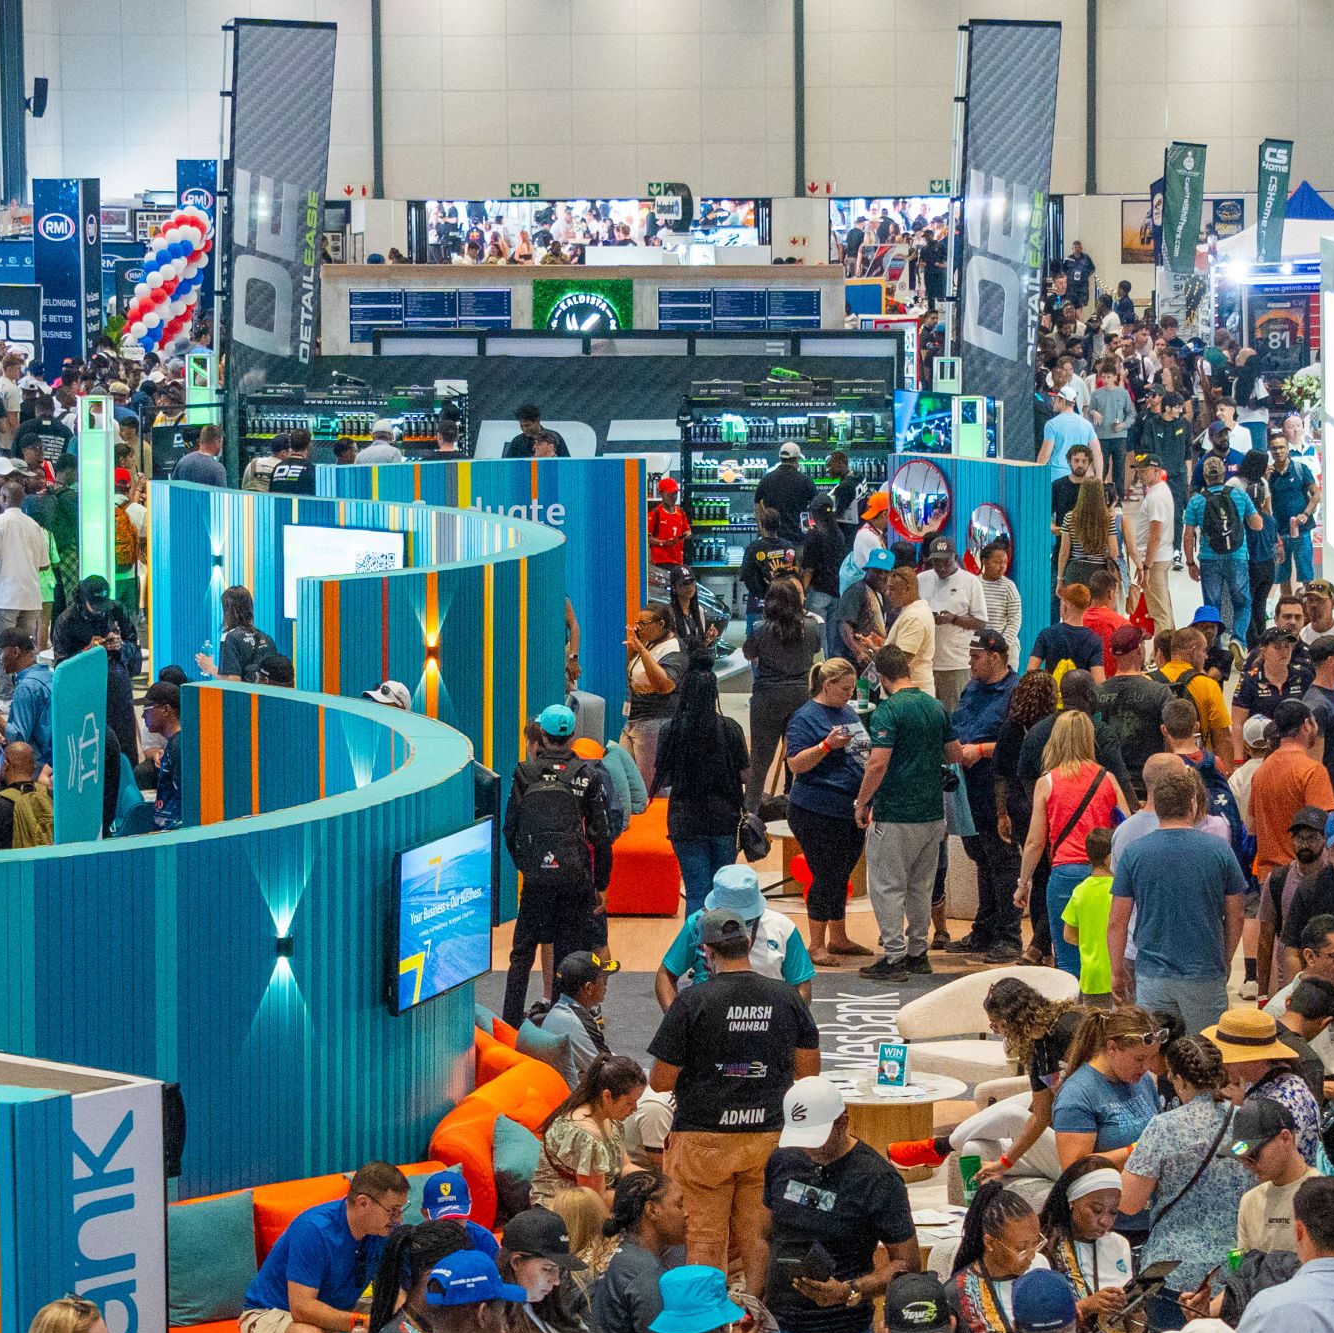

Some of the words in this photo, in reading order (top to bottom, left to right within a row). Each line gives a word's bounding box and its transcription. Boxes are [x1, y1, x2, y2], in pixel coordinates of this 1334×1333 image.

[299, 190, 319, 364] DETAILEASE
[49, 315, 73, 323] BETTER
[1268, 332, 1291, 349] 81
[273, 465, 304, 477] DE
[726, 1006, 772, 1019] ADARSH
[729, 1021, 769, 1032] (MAMBA)
[884, 1048, 903, 1057] WIN
[719, 1108, 766, 1125] ADMIN
